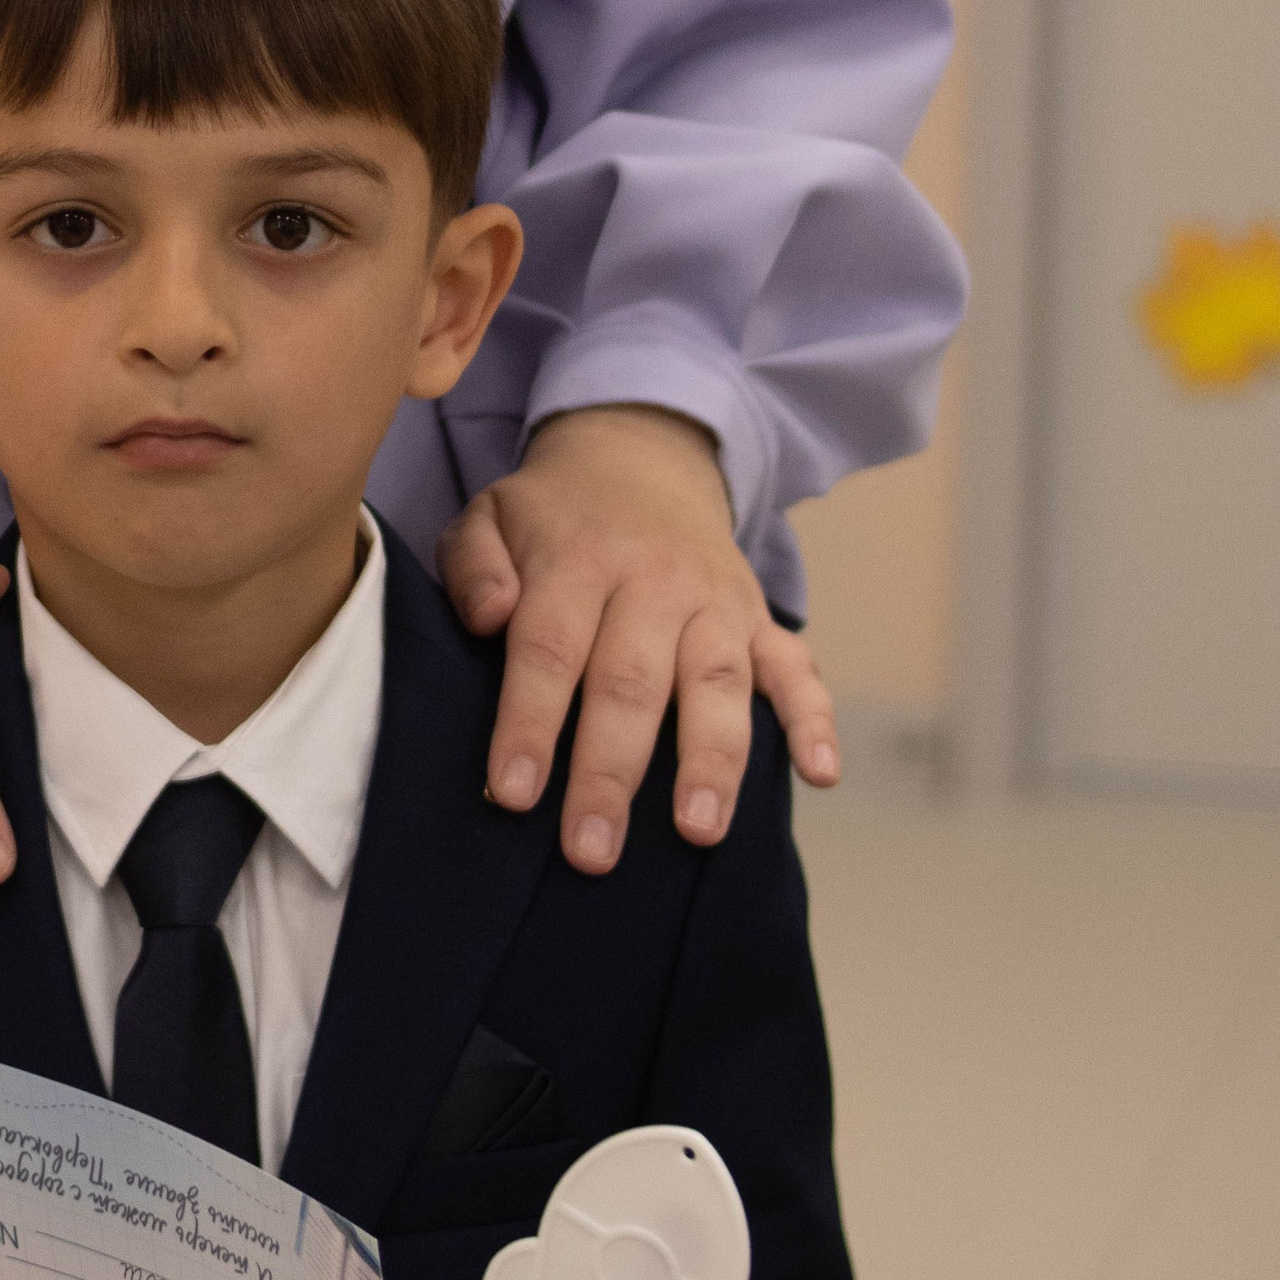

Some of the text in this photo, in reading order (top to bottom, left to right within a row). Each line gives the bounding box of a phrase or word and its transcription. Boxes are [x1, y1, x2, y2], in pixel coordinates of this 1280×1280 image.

[70, 1184, 82, 1201] с
[88, 1192, 167, 1233] может
[123, 1169, 200, 1221] звание
[175, 1216, 249, 1274] теперь
[208, 1206, 281, 1255] носить
